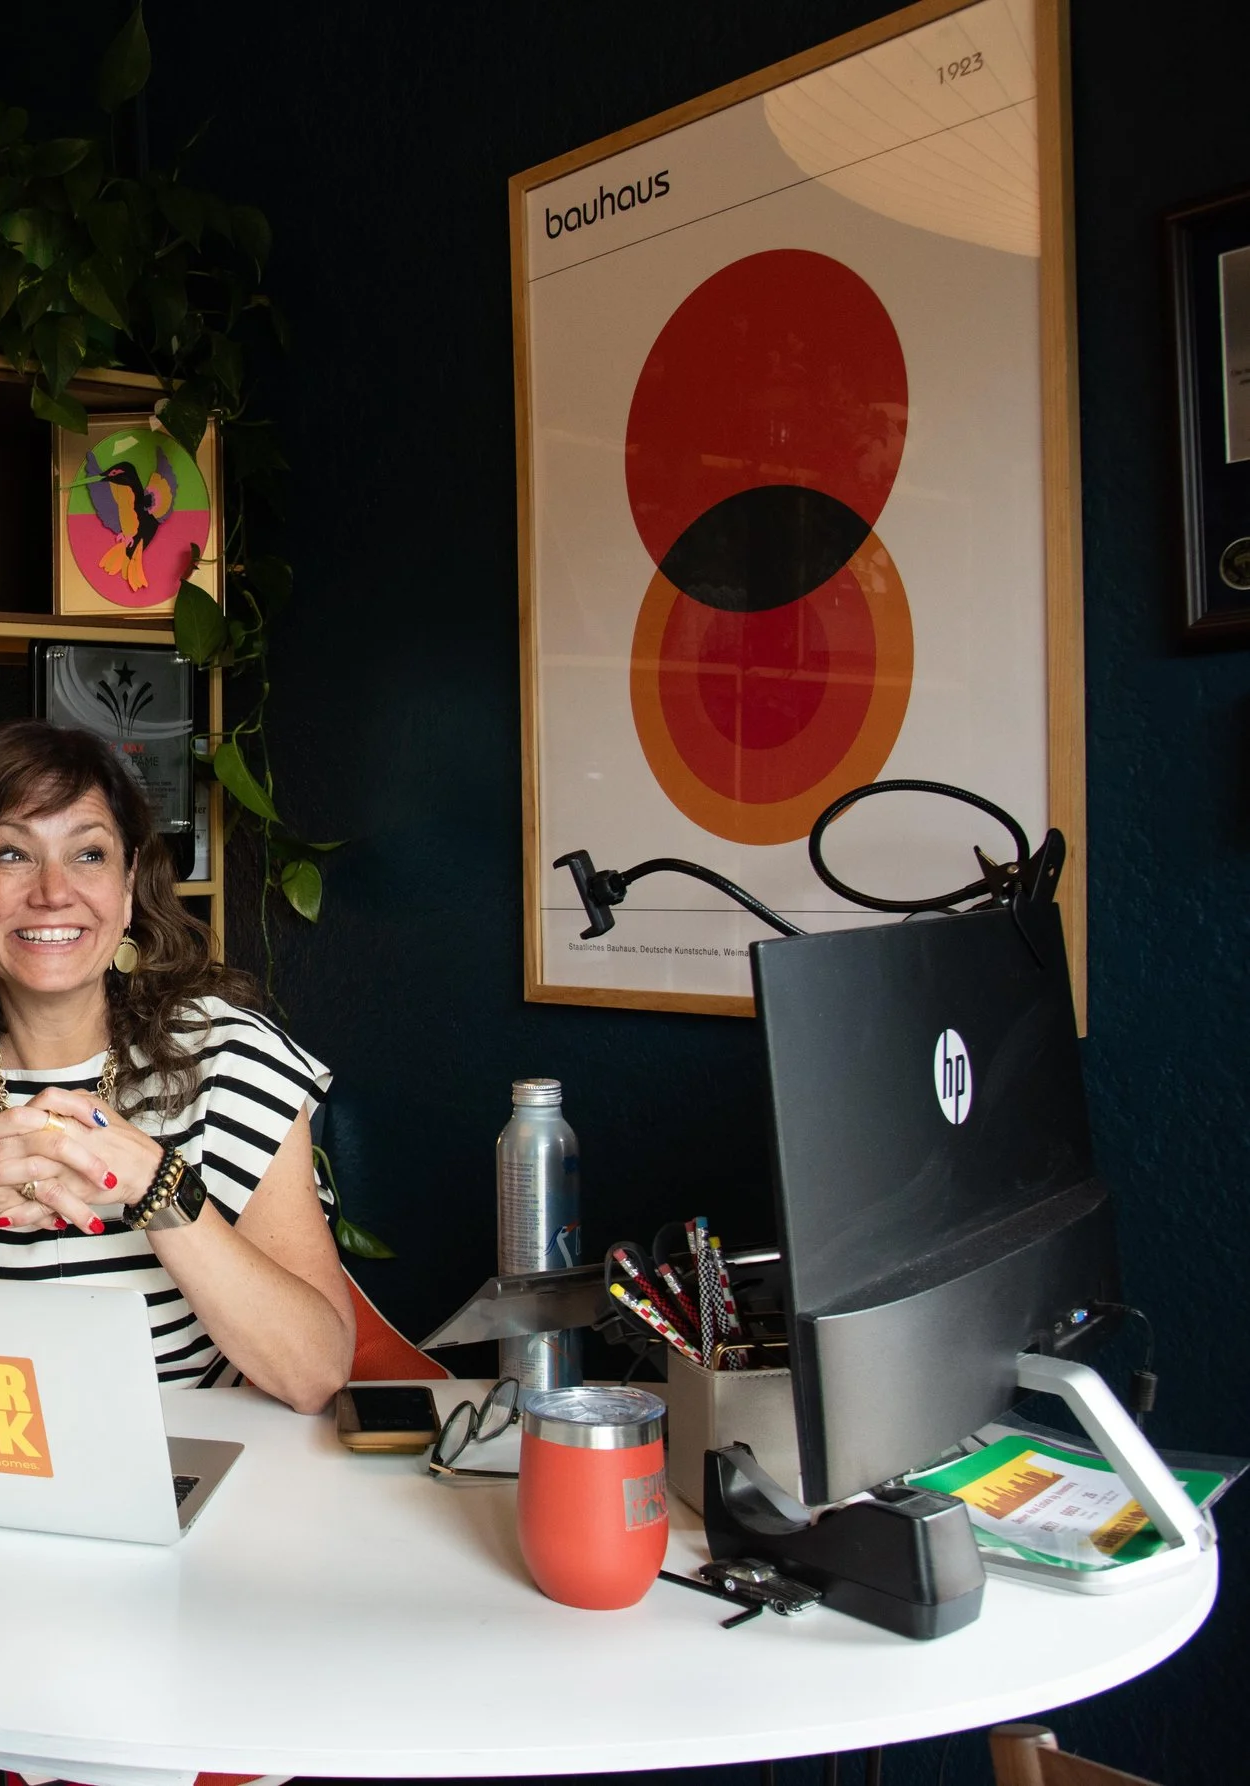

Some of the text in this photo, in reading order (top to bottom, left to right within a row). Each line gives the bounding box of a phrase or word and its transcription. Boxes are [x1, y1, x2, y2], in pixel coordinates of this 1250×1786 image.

[937, 51, 983, 85] 1923
[545, 169, 670, 239] bauhaus
[131, 756, 159, 767] FAME
[568, 942, 749, 957] Staatliches Bauhaus, Deutsche Kunstschule, Weima
[943, 1030, 965, 1124] hp
